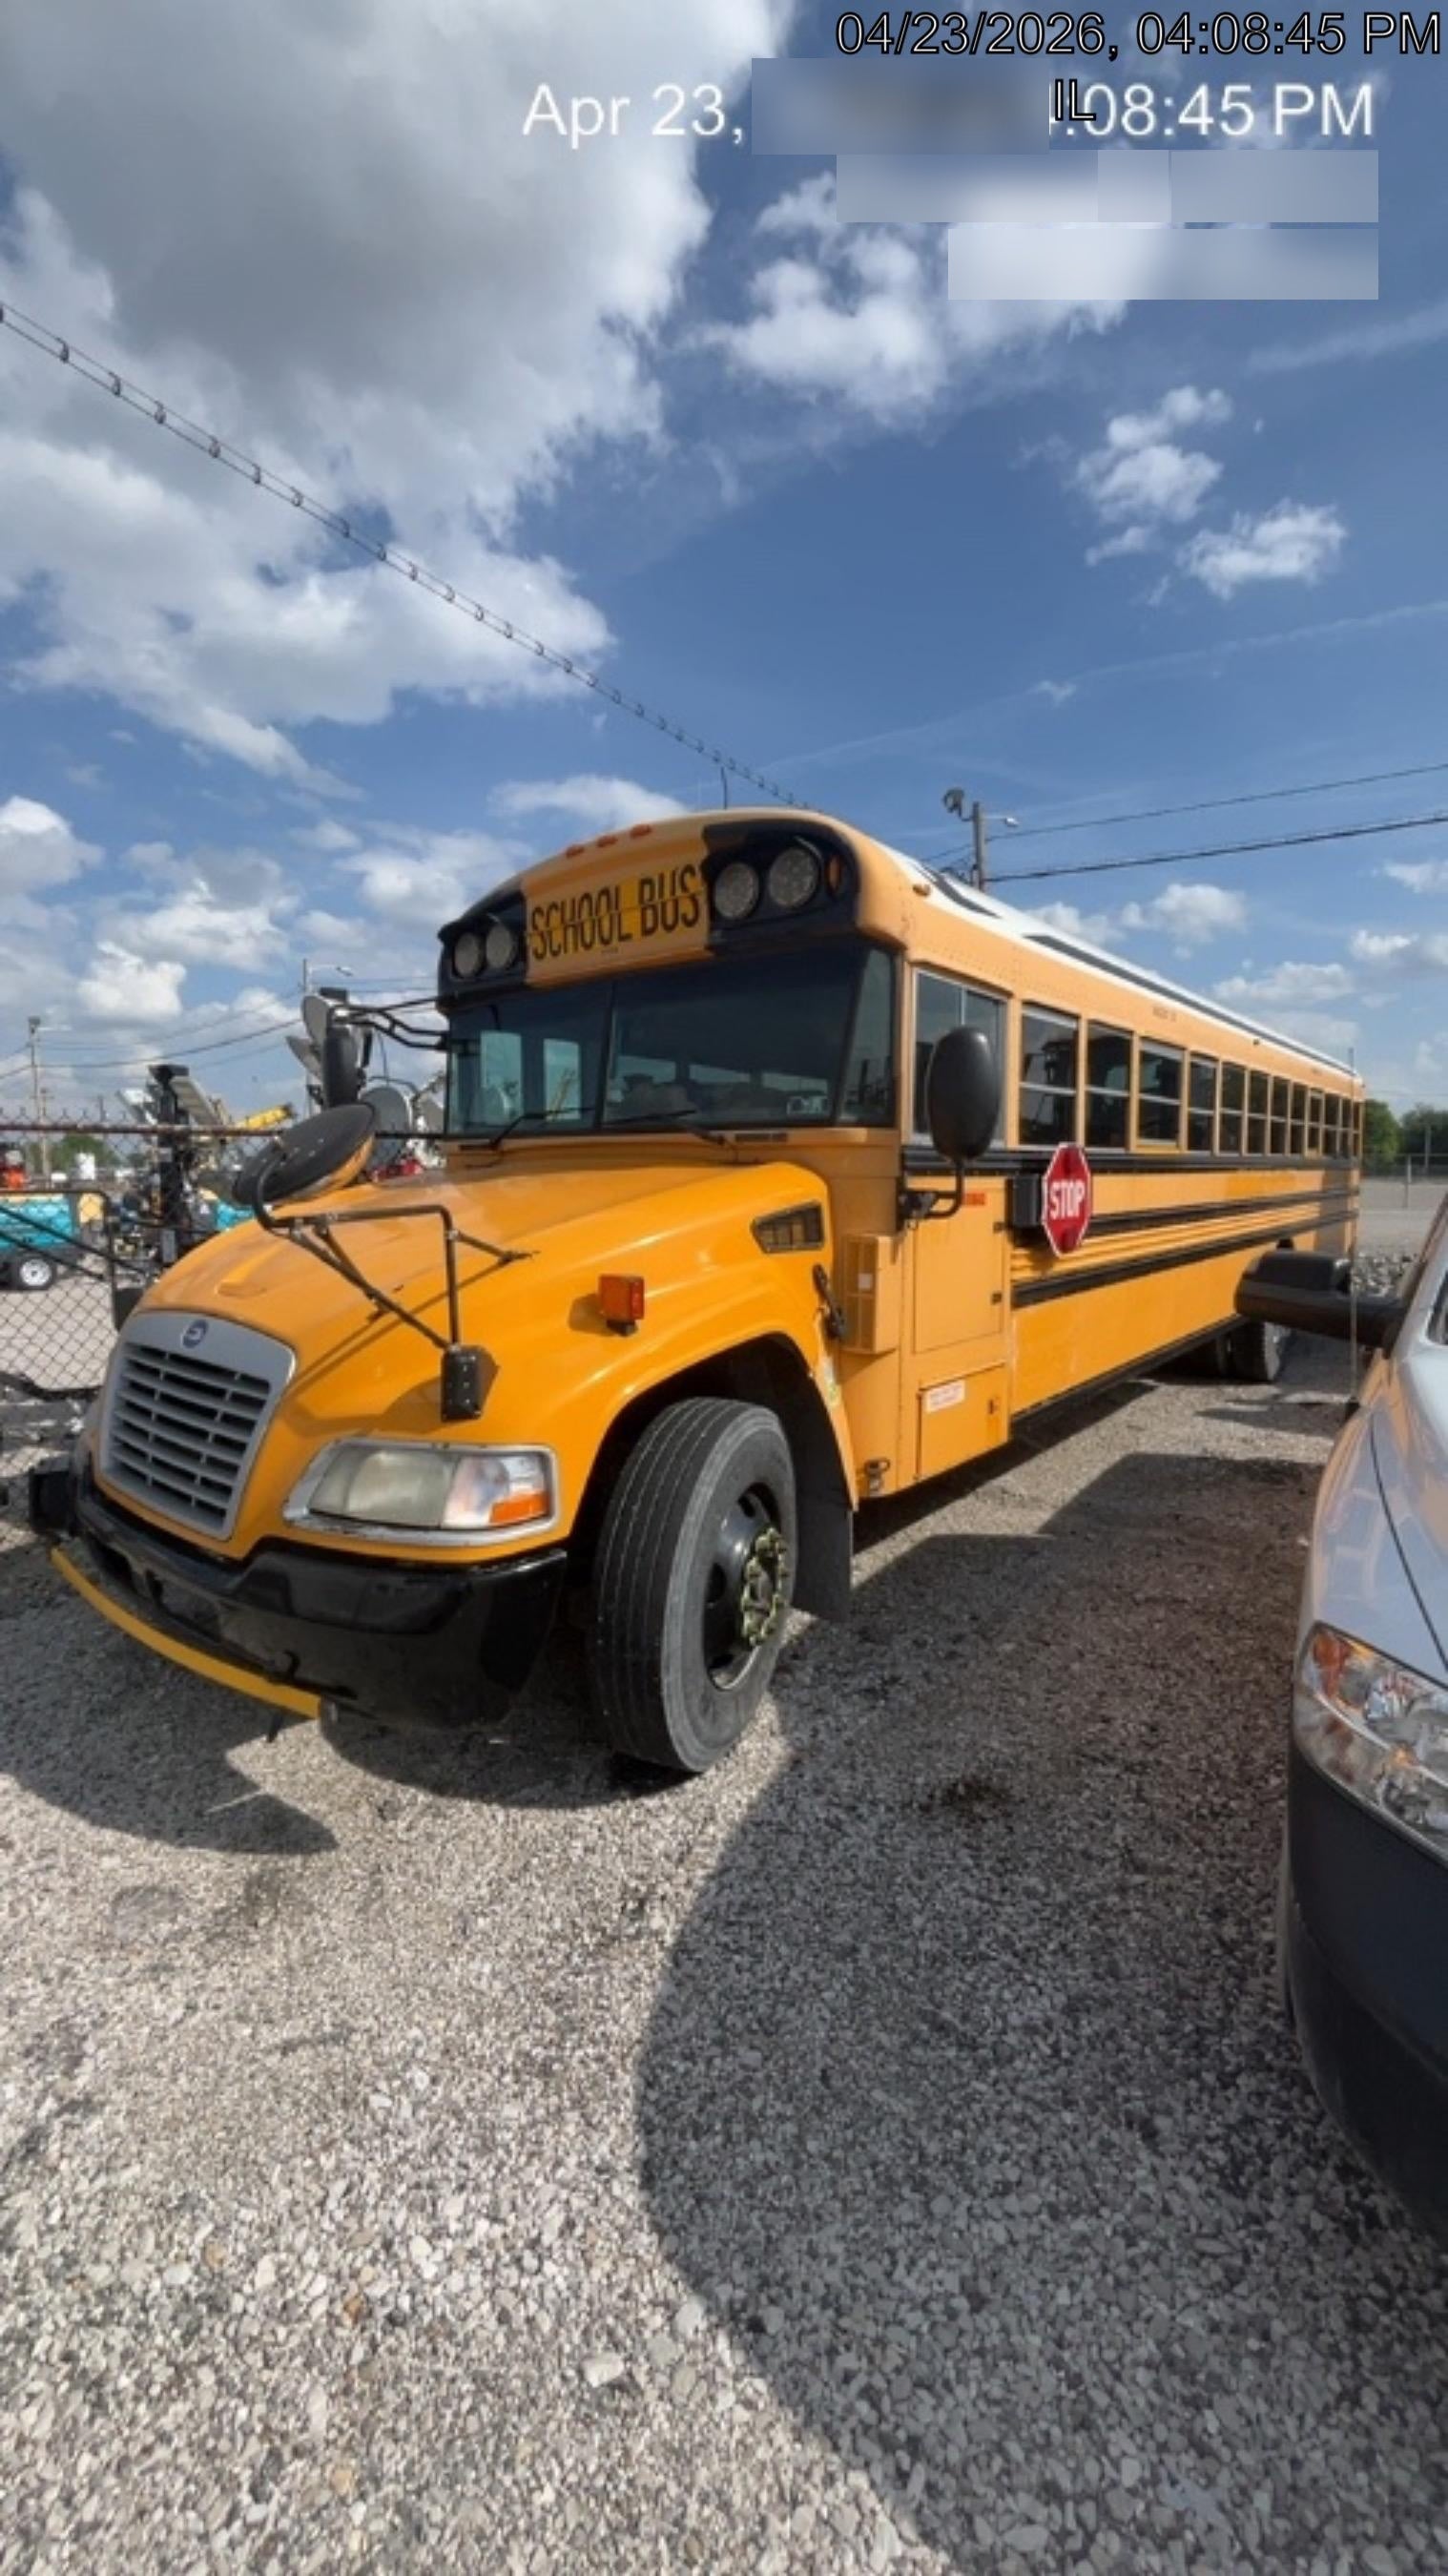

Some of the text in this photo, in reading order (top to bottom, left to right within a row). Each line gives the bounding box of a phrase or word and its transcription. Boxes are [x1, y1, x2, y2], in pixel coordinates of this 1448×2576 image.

[531, 863, 699, 960] SCHOOL BUS
[1050, 1180, 1085, 1220] STOP
